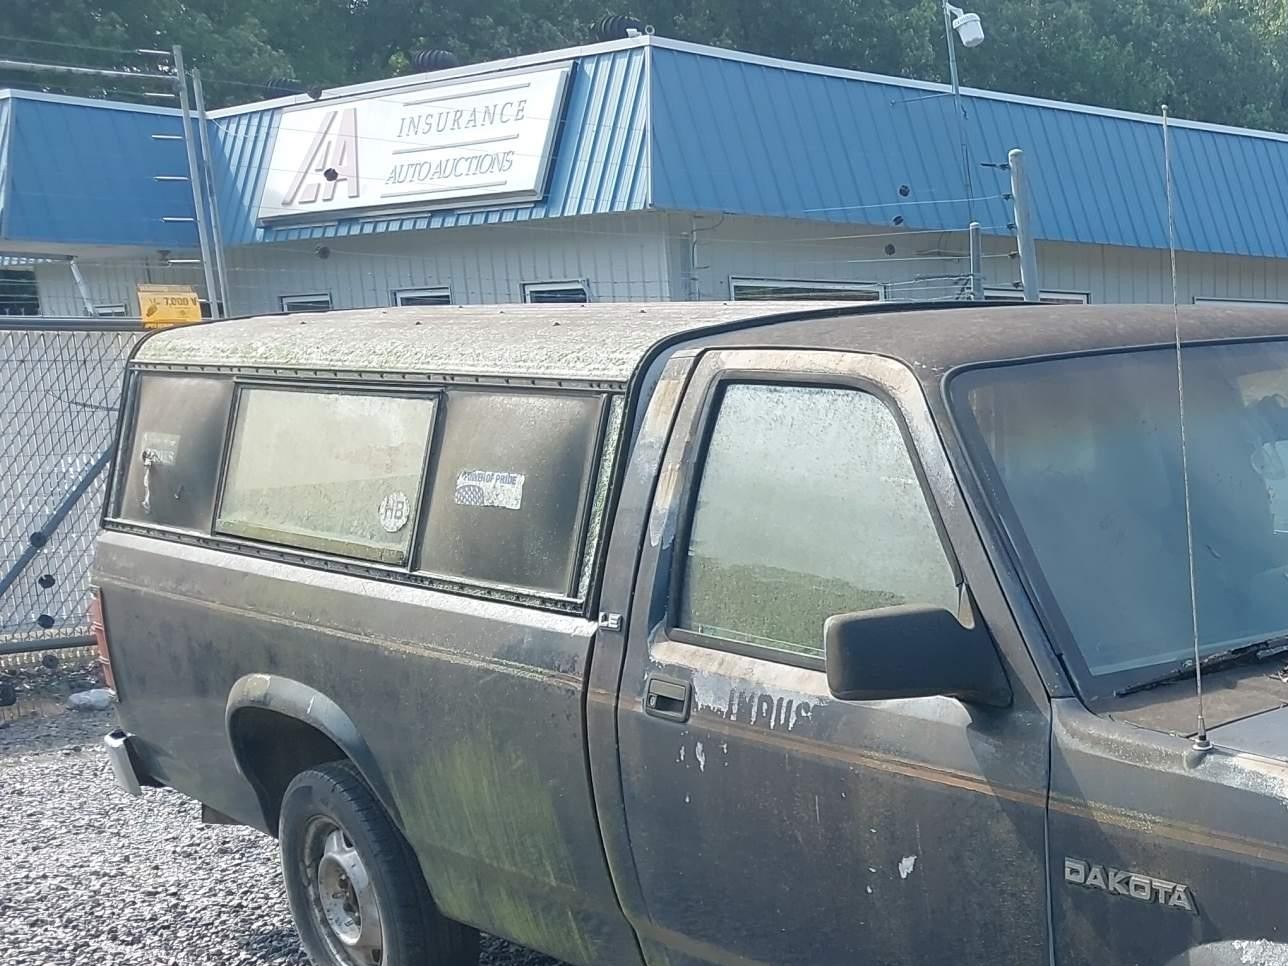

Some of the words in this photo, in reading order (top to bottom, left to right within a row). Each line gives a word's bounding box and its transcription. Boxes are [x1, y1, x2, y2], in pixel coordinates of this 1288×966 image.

[396, 99, 527, 138] INSURANCE
[486, 473, 495, 483] OF
[496, 474, 517, 486] PRIDE
[384, 498, 405, 520] HB
[599, 612, 621, 628] LE
[1064, 857, 1194, 912] DAKOTA
